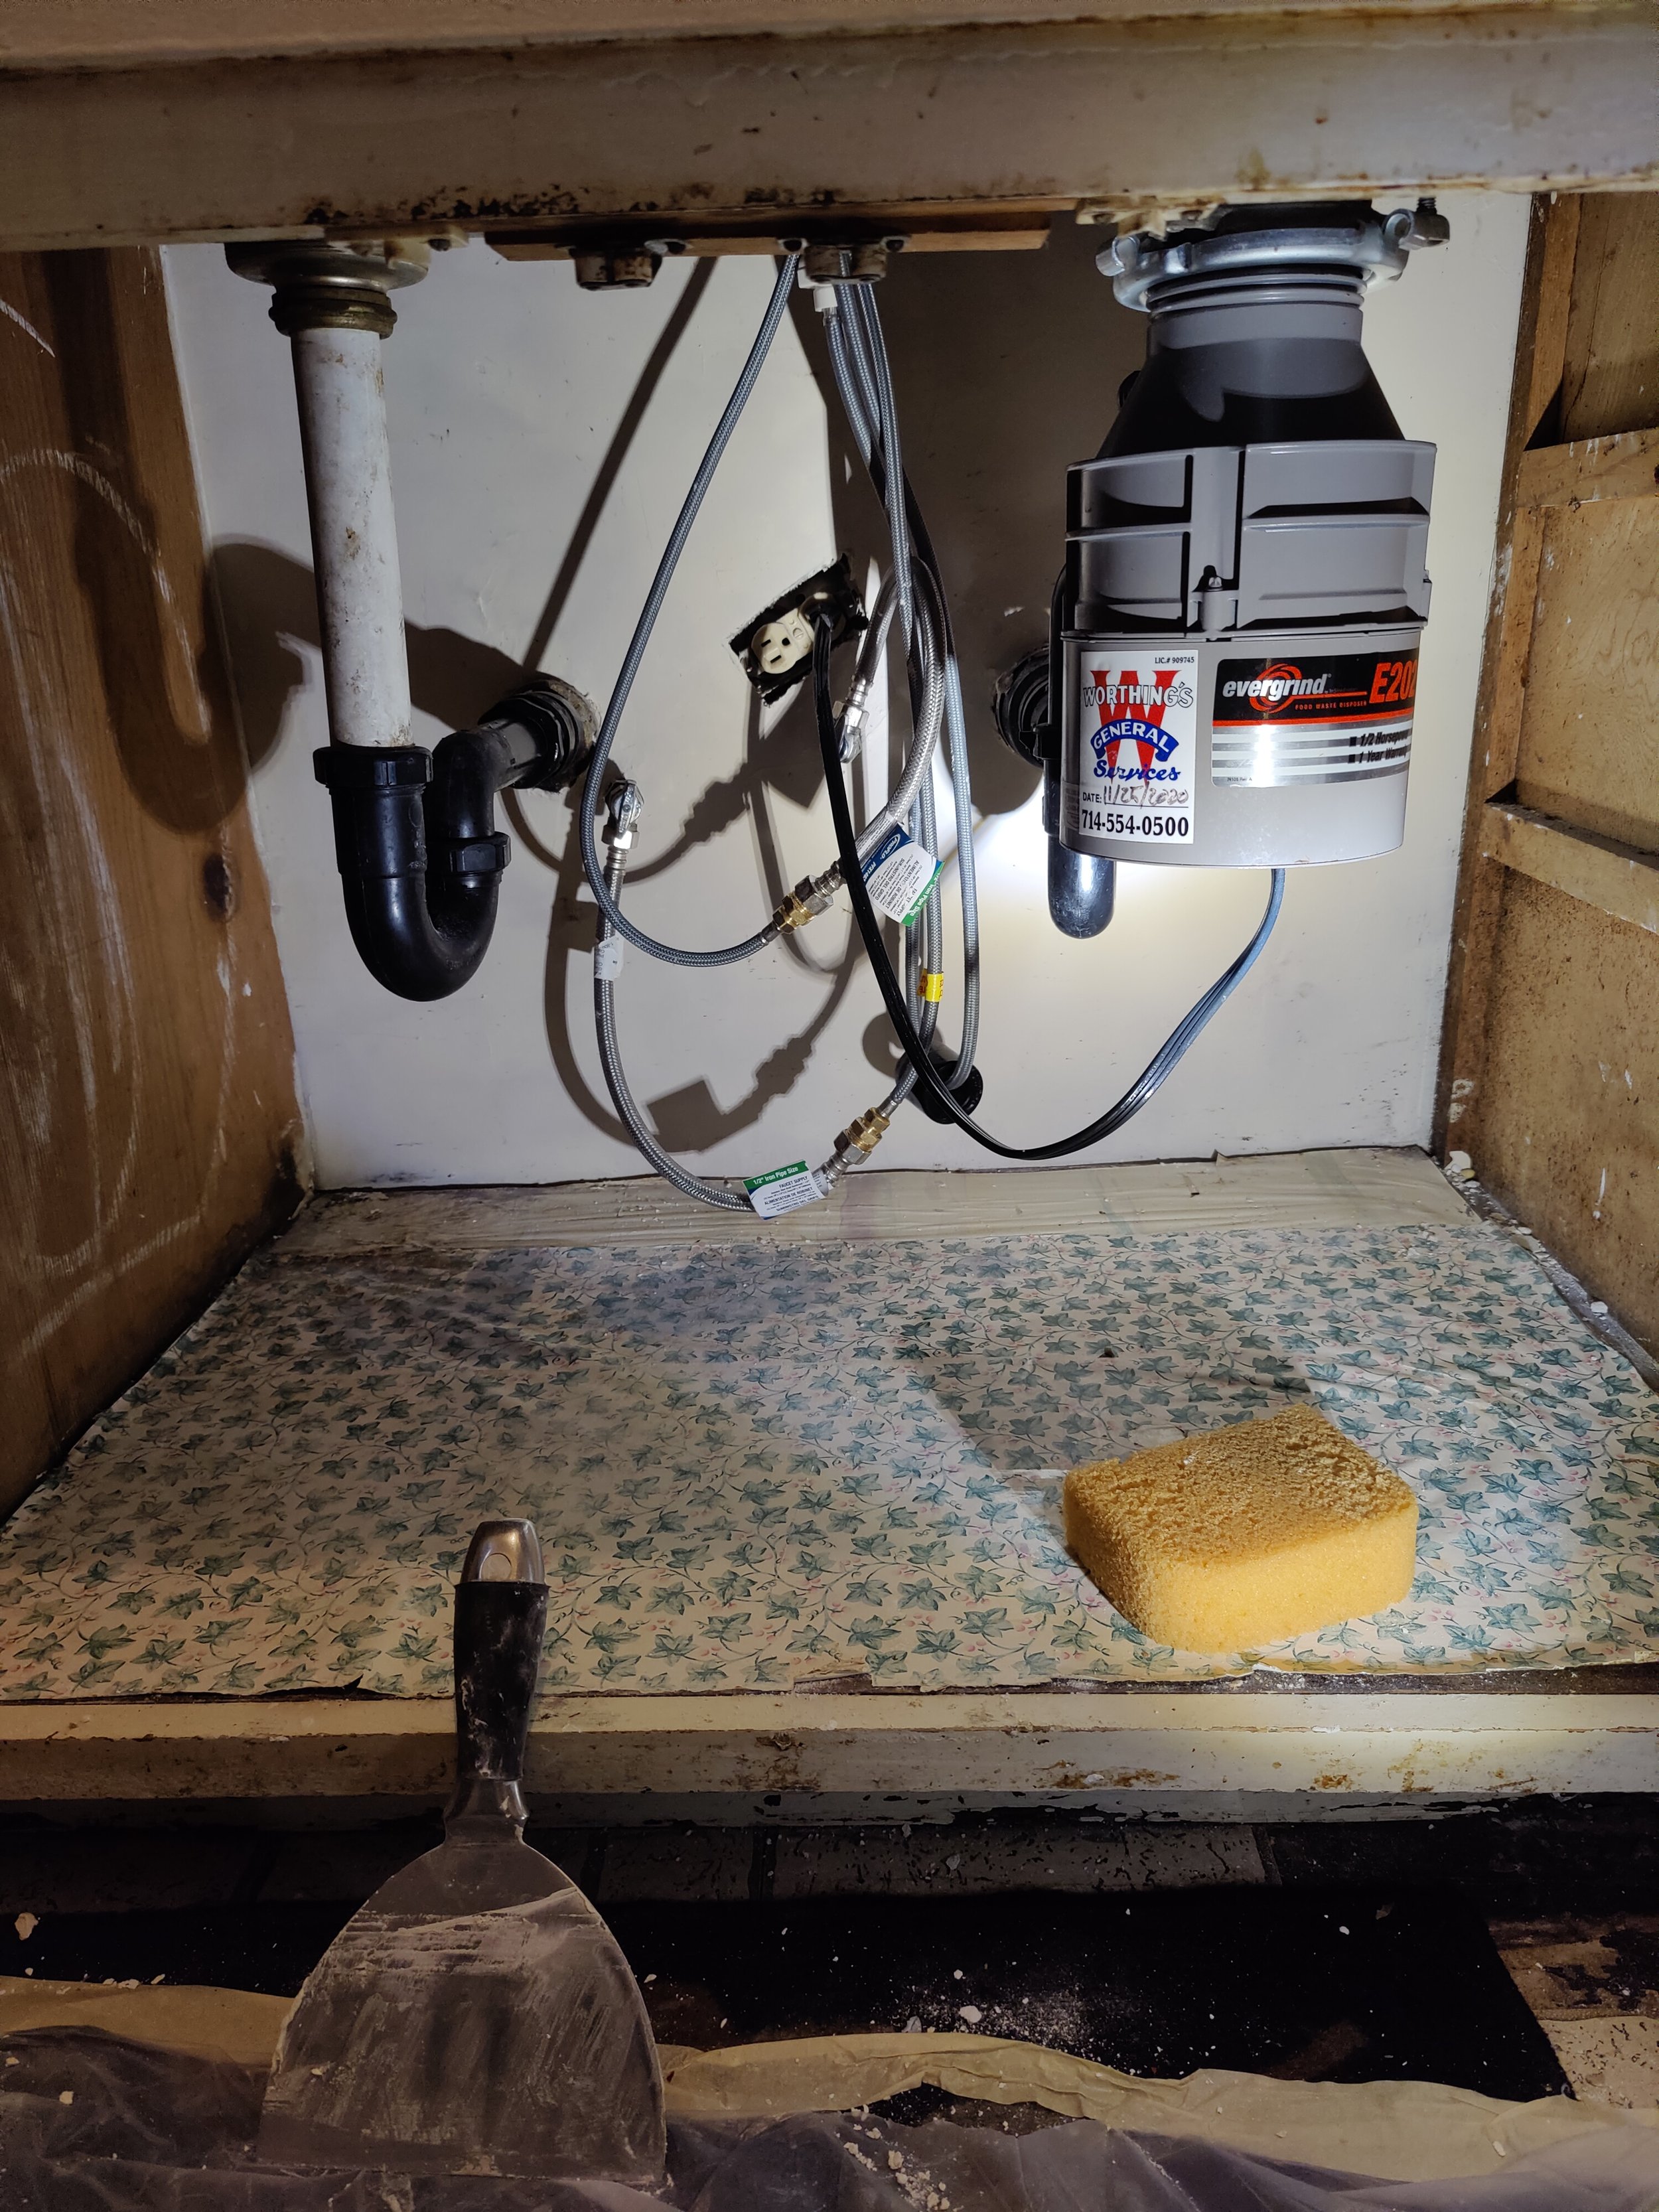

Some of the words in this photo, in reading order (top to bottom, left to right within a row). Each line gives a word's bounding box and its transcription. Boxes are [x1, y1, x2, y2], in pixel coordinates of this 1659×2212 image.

[1222, 674, 1327, 701] evergrind
[1082, 682, 1194, 708] WORTHING'S
[1094, 721, 1169, 753] GENERAL
[1360, 733, 1375, 747] 1/2
[1359, 751, 1364, 764] 1
[1367, 750, 1384, 763] Year
[1094, 759, 1181, 782] Services
[1082, 792, 1102, 803] DATE:
[1104, 781, 1189, 809] 11/25/2020
[1082, 809, 1189, 836] 714-554-0500
[899, 859, 920, 889] ALIMENTATIO
[875, 888, 885, 901] GRIFO
[905, 888, 917, 903] FAET
[925, 883, 935, 895] Iron
[885, 892, 898, 909] ROBINET
[917, 894, 928, 907] Pipe
[896, 903, 907, 917] UPPLY
[910, 905, 920, 917] Size
[775, 1170, 788, 1179] Pipe
